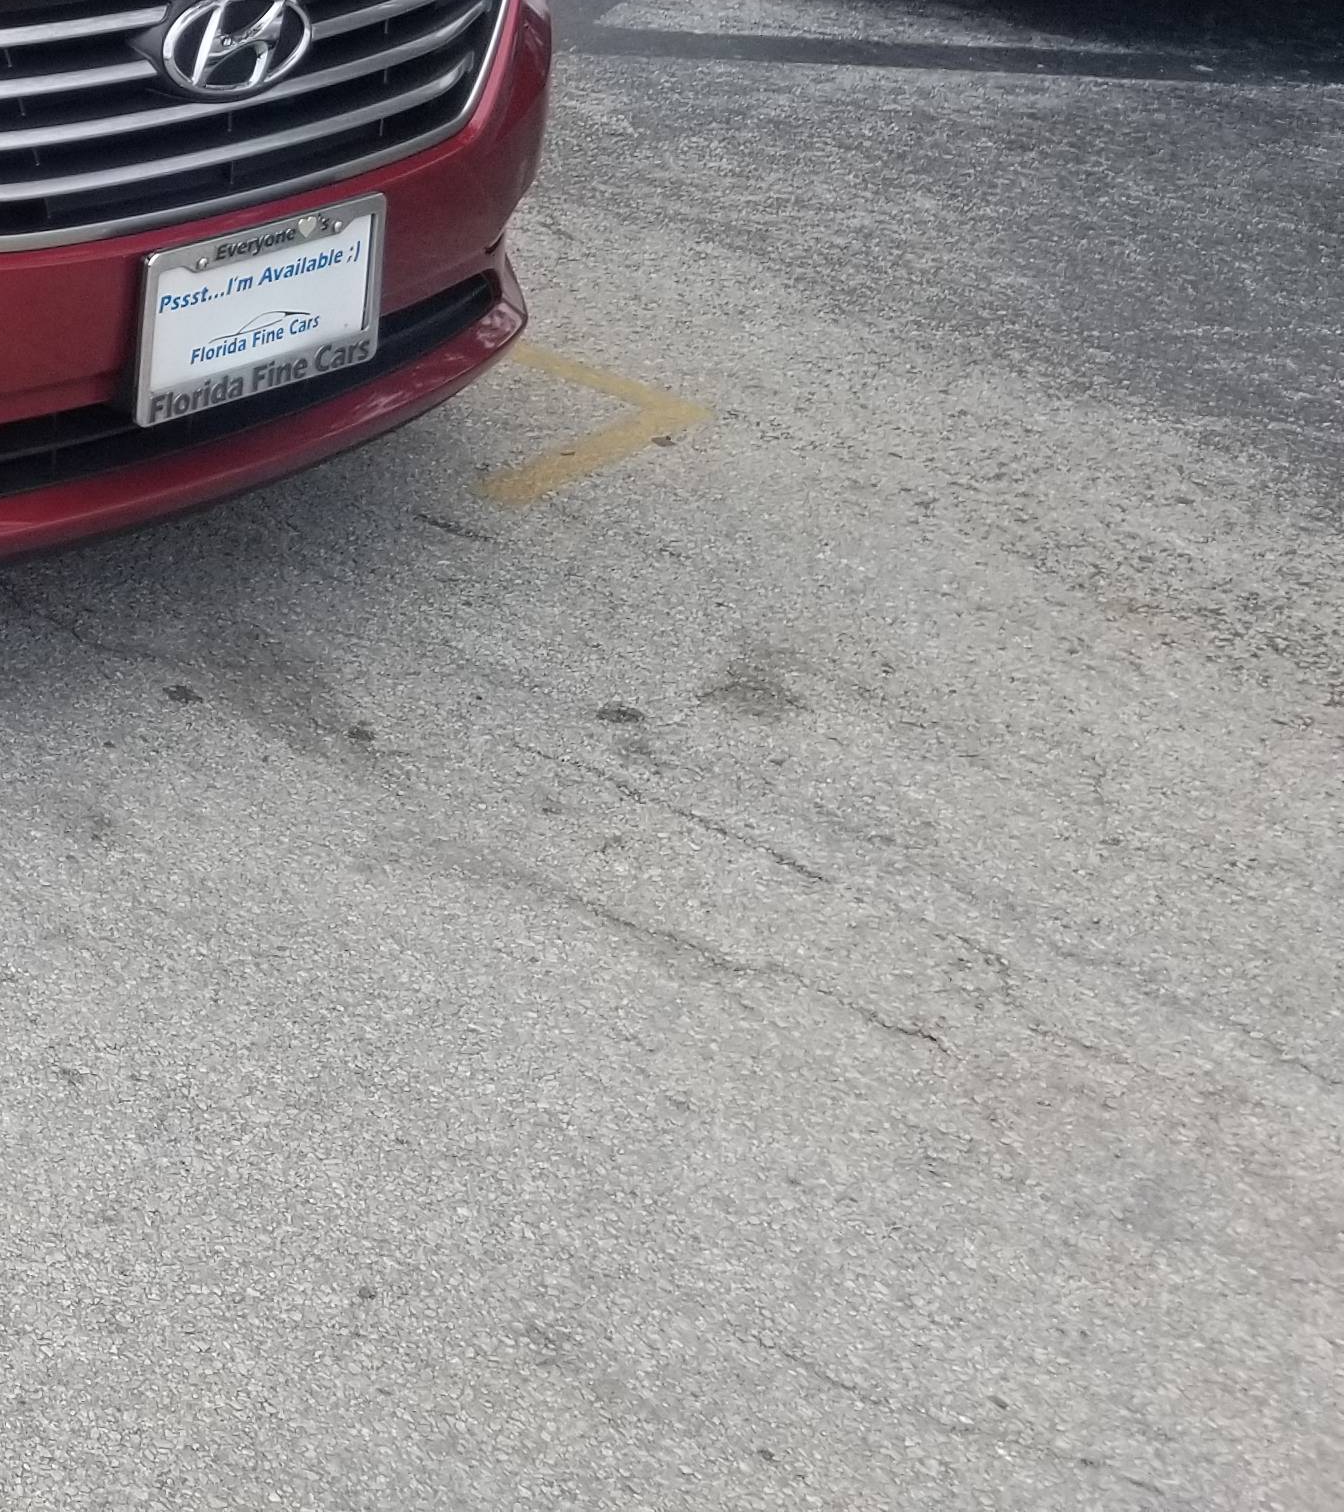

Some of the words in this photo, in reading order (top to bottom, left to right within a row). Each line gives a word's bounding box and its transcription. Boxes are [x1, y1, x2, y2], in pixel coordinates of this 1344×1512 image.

[215, 229, 296, 261] Everyone
[257, 248, 344, 286] Available
[190, 337, 247, 365] Florida
[252, 326, 285, 348] Fine
[289, 315, 321, 336] Cars
[148, 375, 244, 424] Florida
[253, 357, 309, 392] Fine
[314, 339, 371, 372] Cars
